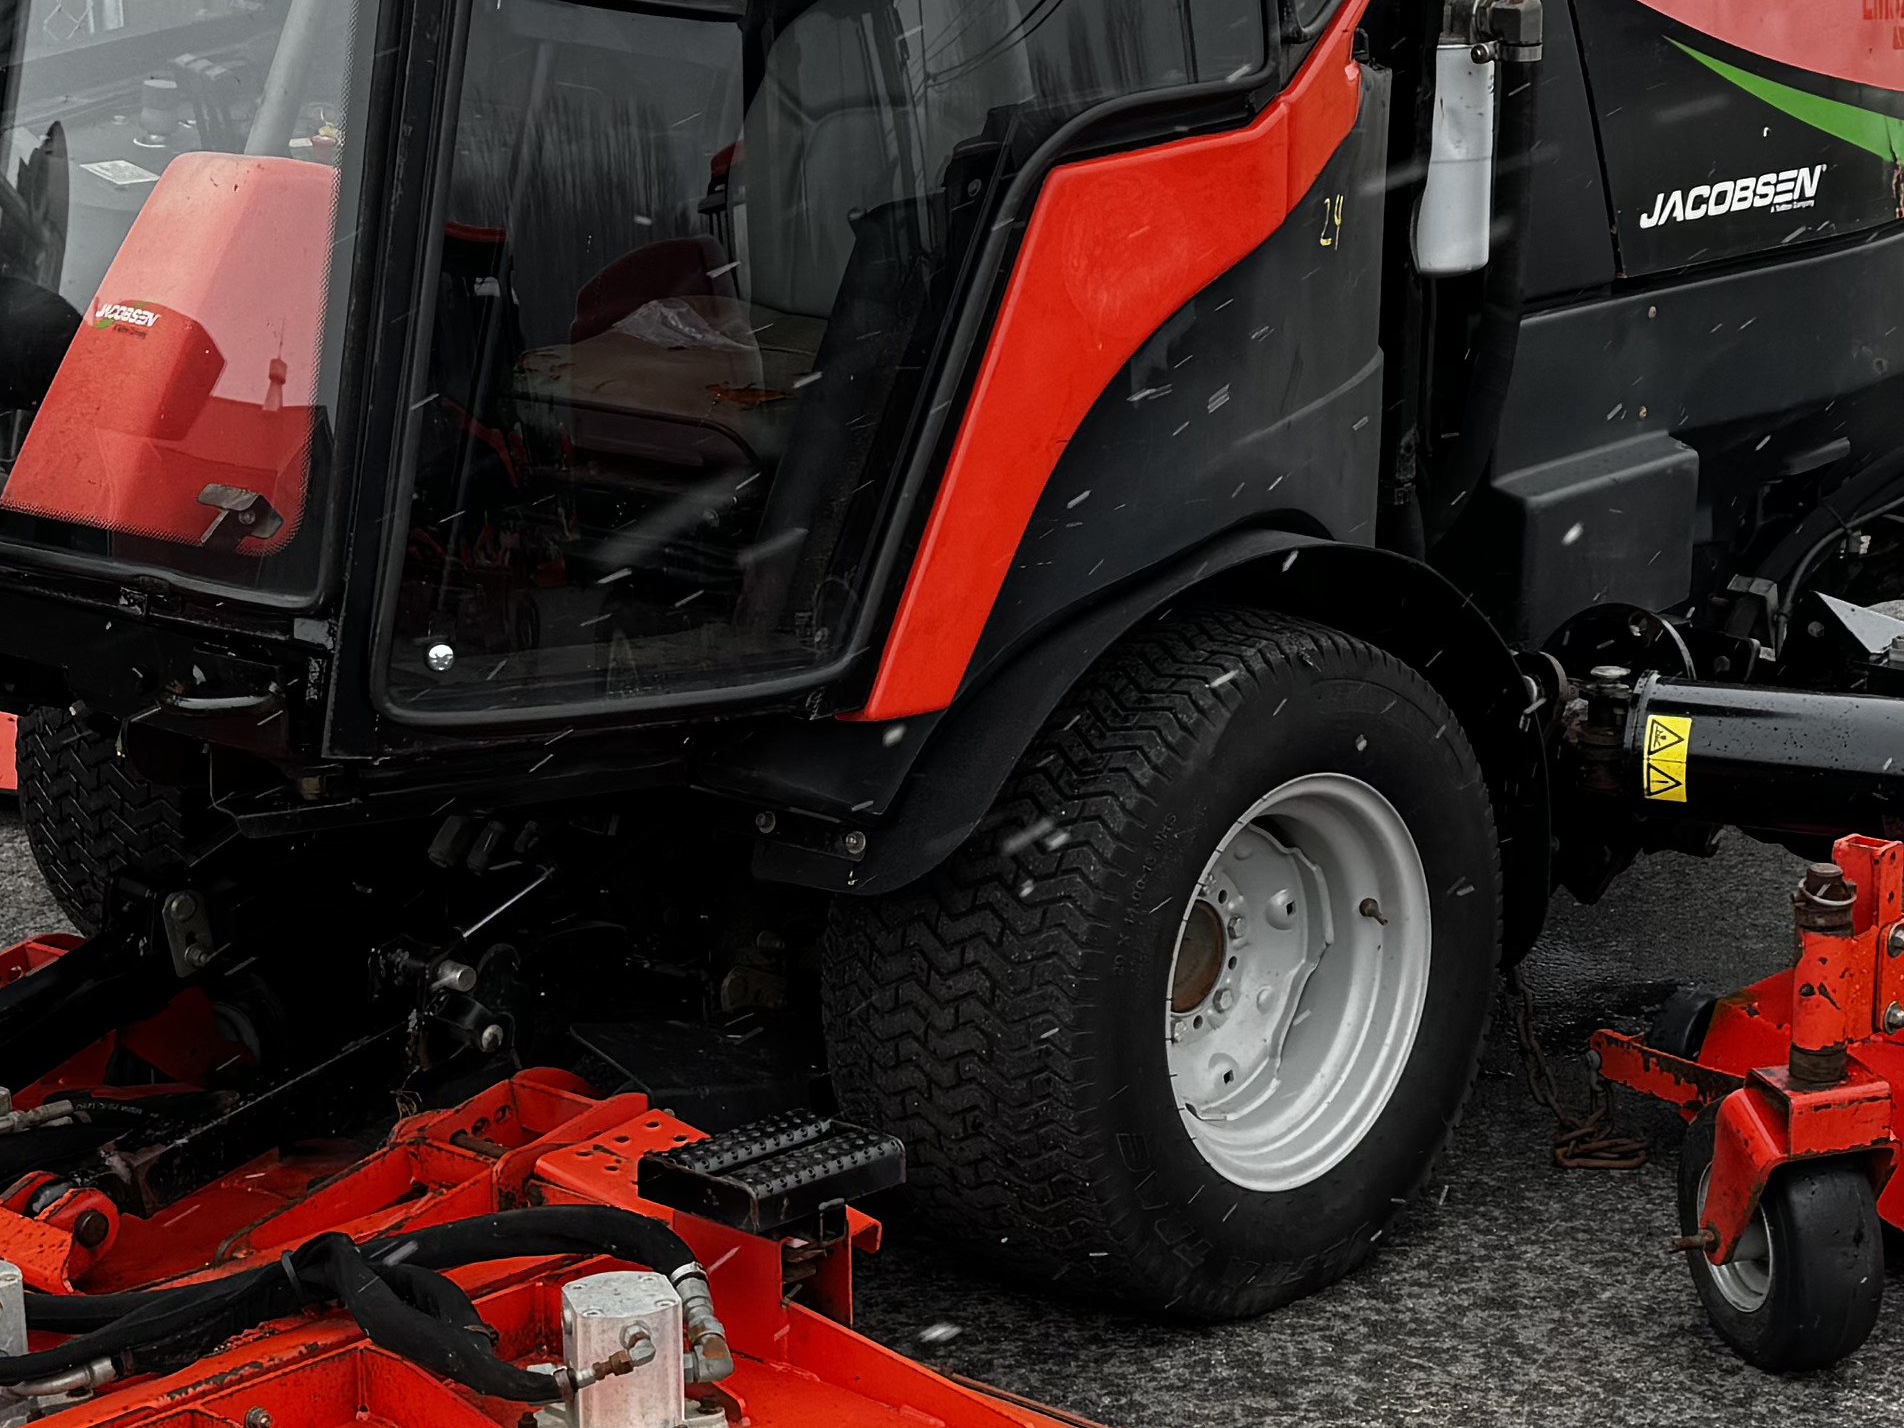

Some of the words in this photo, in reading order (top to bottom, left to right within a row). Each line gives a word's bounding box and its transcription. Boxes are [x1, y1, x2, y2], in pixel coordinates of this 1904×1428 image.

[1319, 194, 1344, 251] 24
[1639, 164, 1823, 229] JACOBSEN
[95, 303, 162, 327] JACOBSEN
